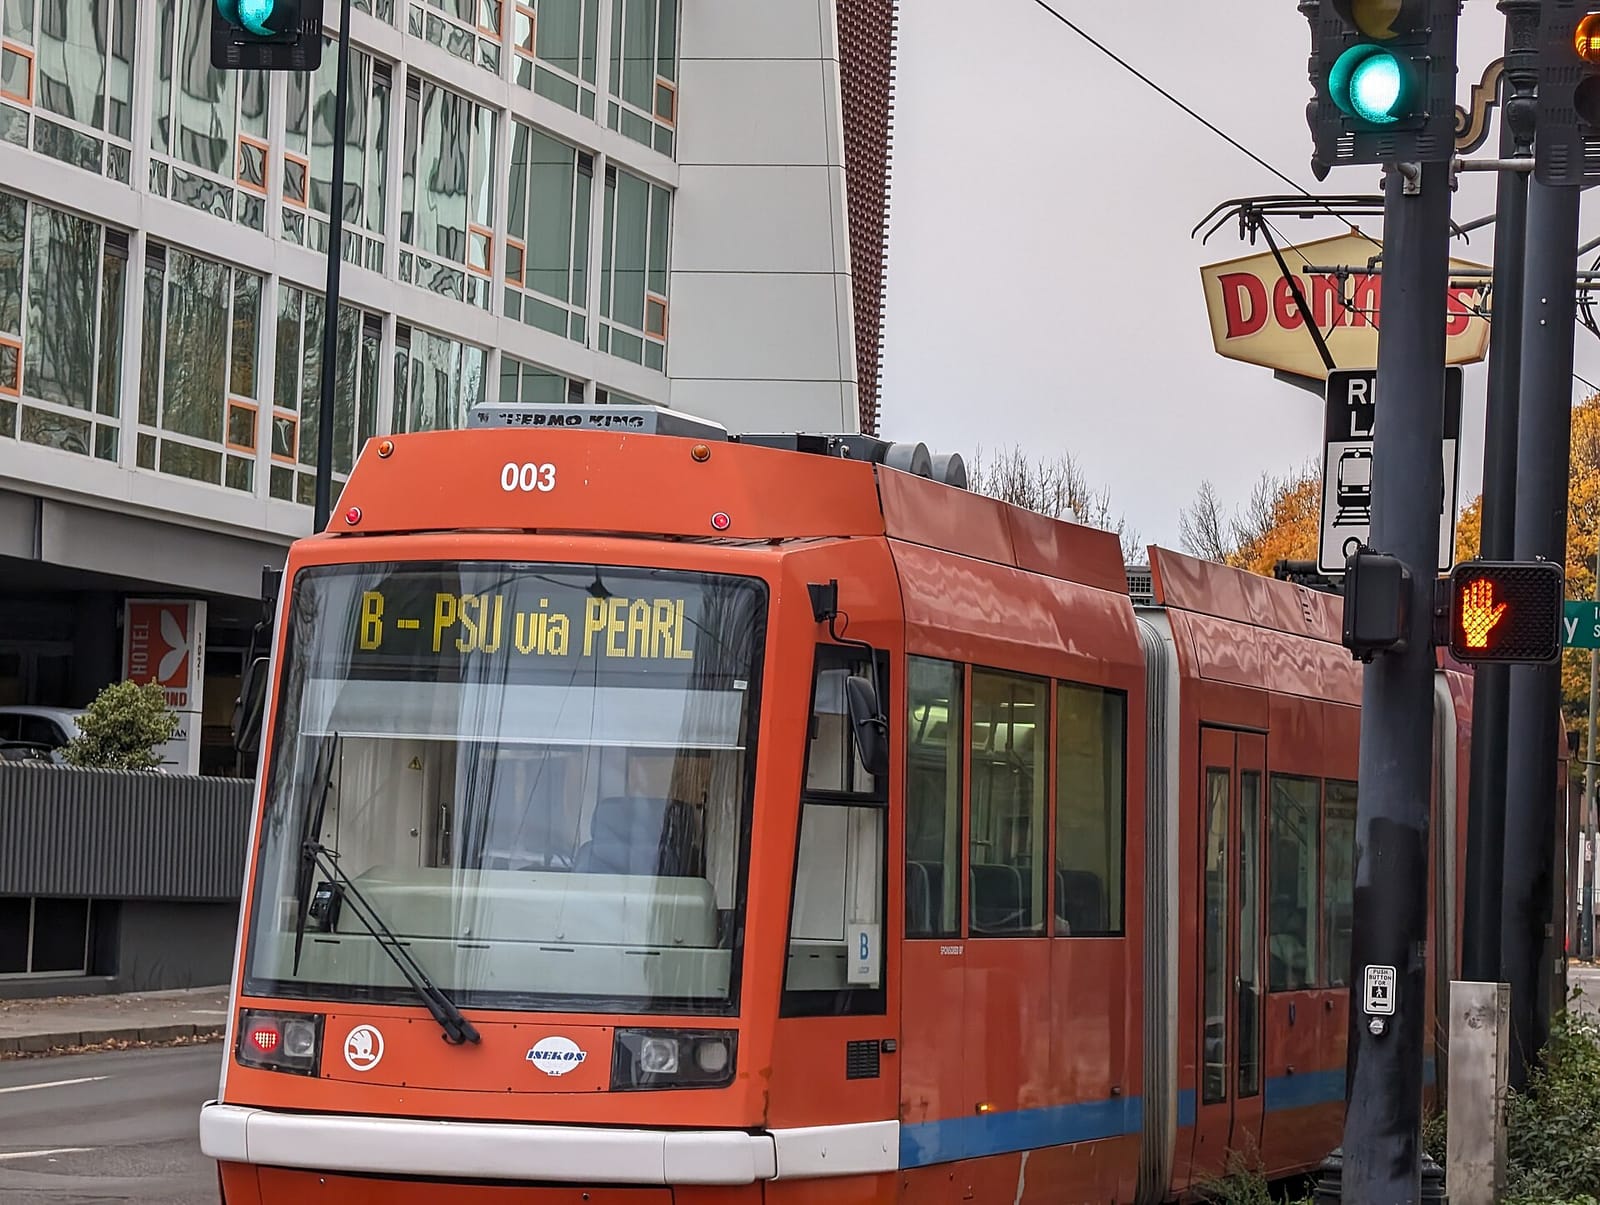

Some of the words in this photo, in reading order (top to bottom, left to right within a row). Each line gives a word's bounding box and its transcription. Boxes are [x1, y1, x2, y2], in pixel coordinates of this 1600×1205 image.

[589, 415, 645, 428] KING
[501, 462, 556, 492] 003
[360, 591, 385, 650] B
[432, 592, 503, 654] PSU
[514, 598, 570, 656] via
[583, 597, 693, 660] PEARL
[132, 623, 149, 675] HOTEL
[860, 932, 869, 961] B
